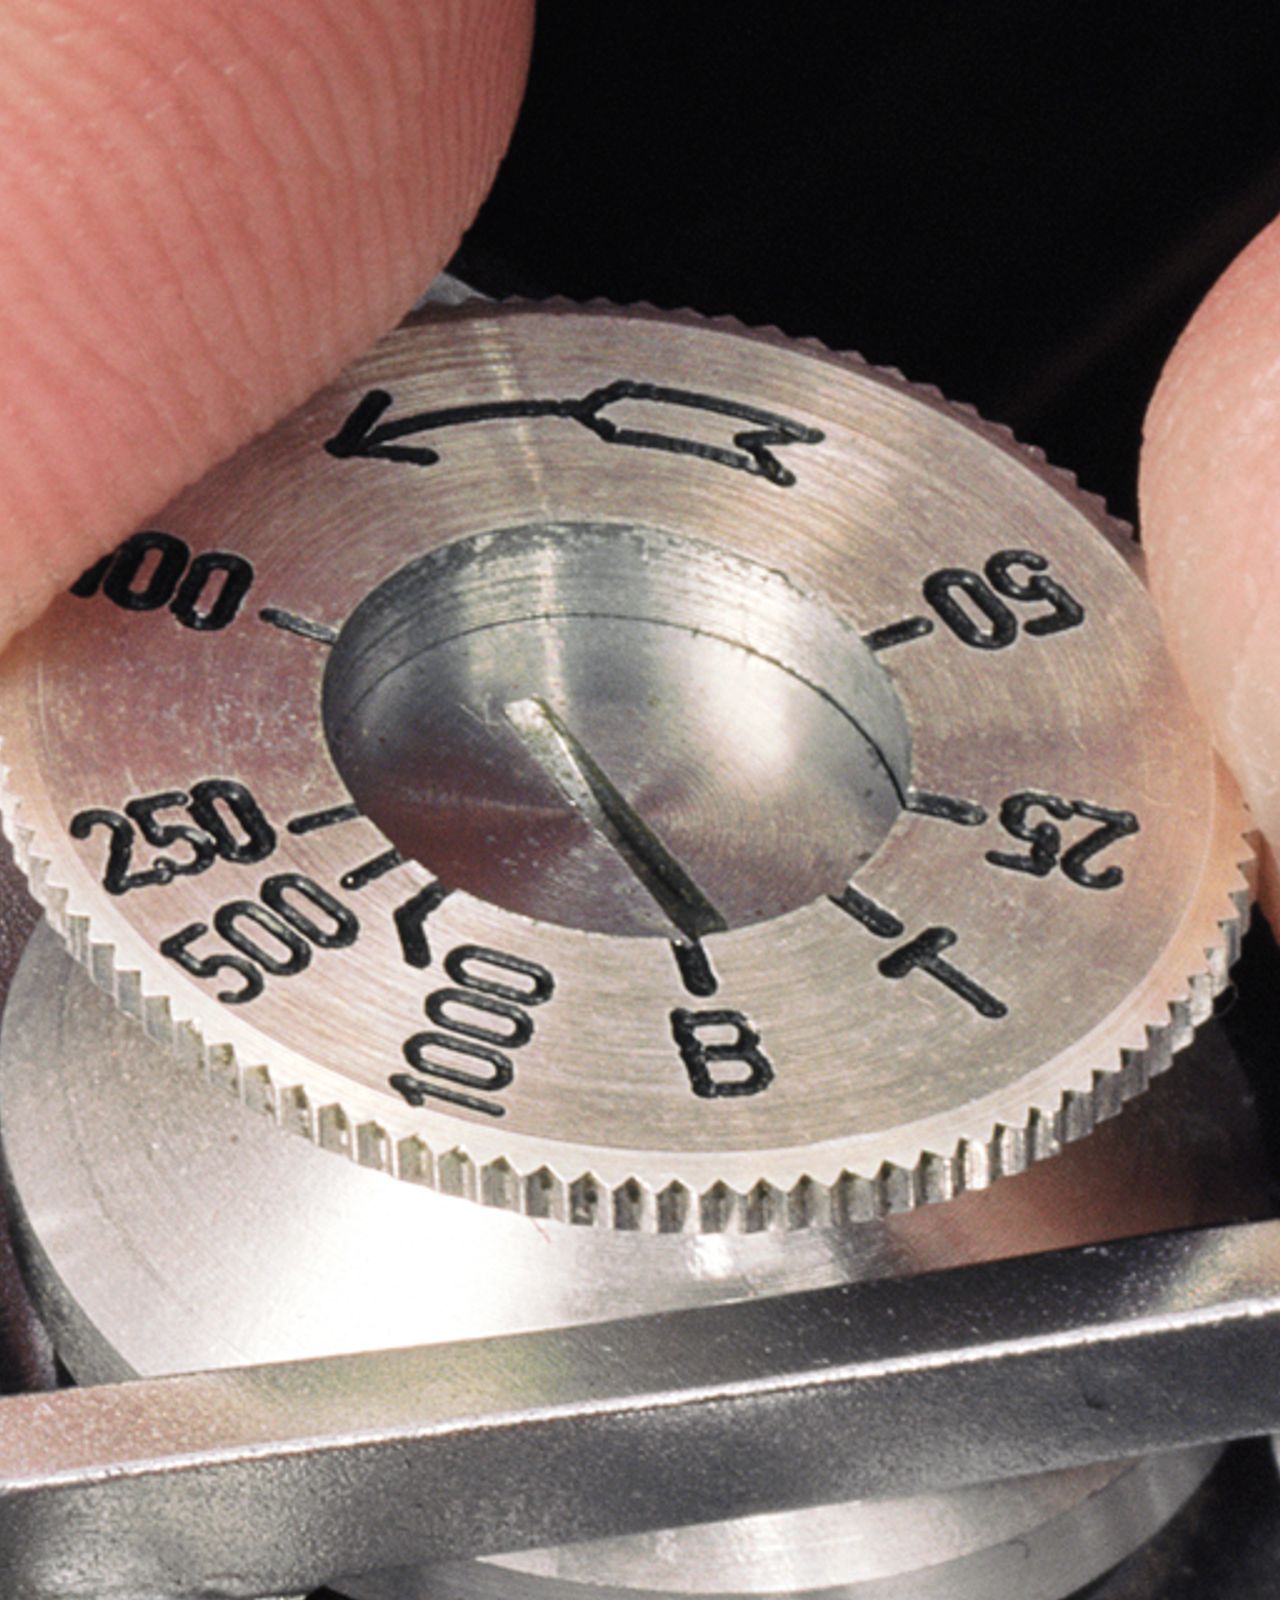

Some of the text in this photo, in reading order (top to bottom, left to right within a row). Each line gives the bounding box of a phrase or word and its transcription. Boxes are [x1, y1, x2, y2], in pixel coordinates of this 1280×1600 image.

[923, 548, 1085, 650] 50
[70, 778, 276, 896] 250
[986, 791, 1141, 890] 25
[160, 873, 360, 1005] 500
[880, 926, 1009, 1020] T
[388, 943, 556, 1117] 1000
[670, 1008, 774, 1099] B
